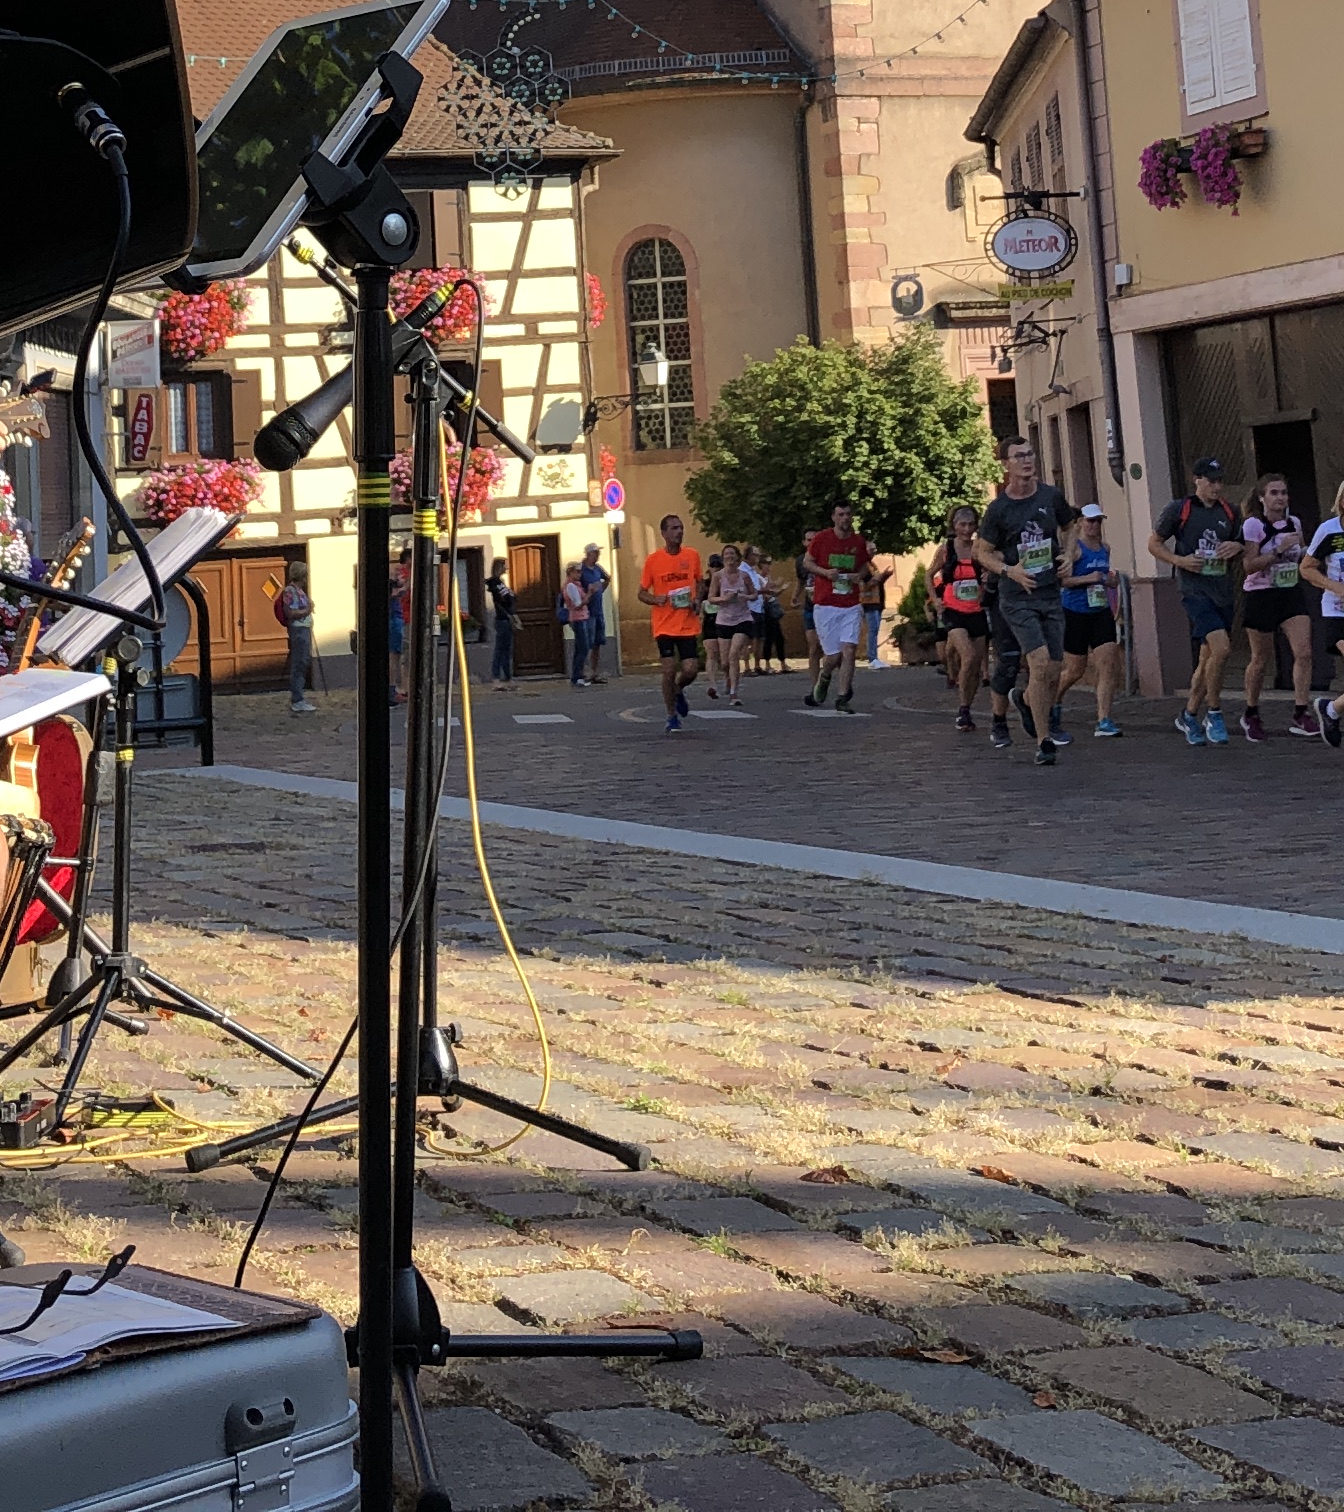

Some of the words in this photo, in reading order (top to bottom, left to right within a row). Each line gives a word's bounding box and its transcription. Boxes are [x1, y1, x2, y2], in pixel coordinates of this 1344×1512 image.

[1003, 235, 1061, 255] METEOR
[1040, 288, 1072, 297] COCHON
[134, 396, 150, 458] TABAC
